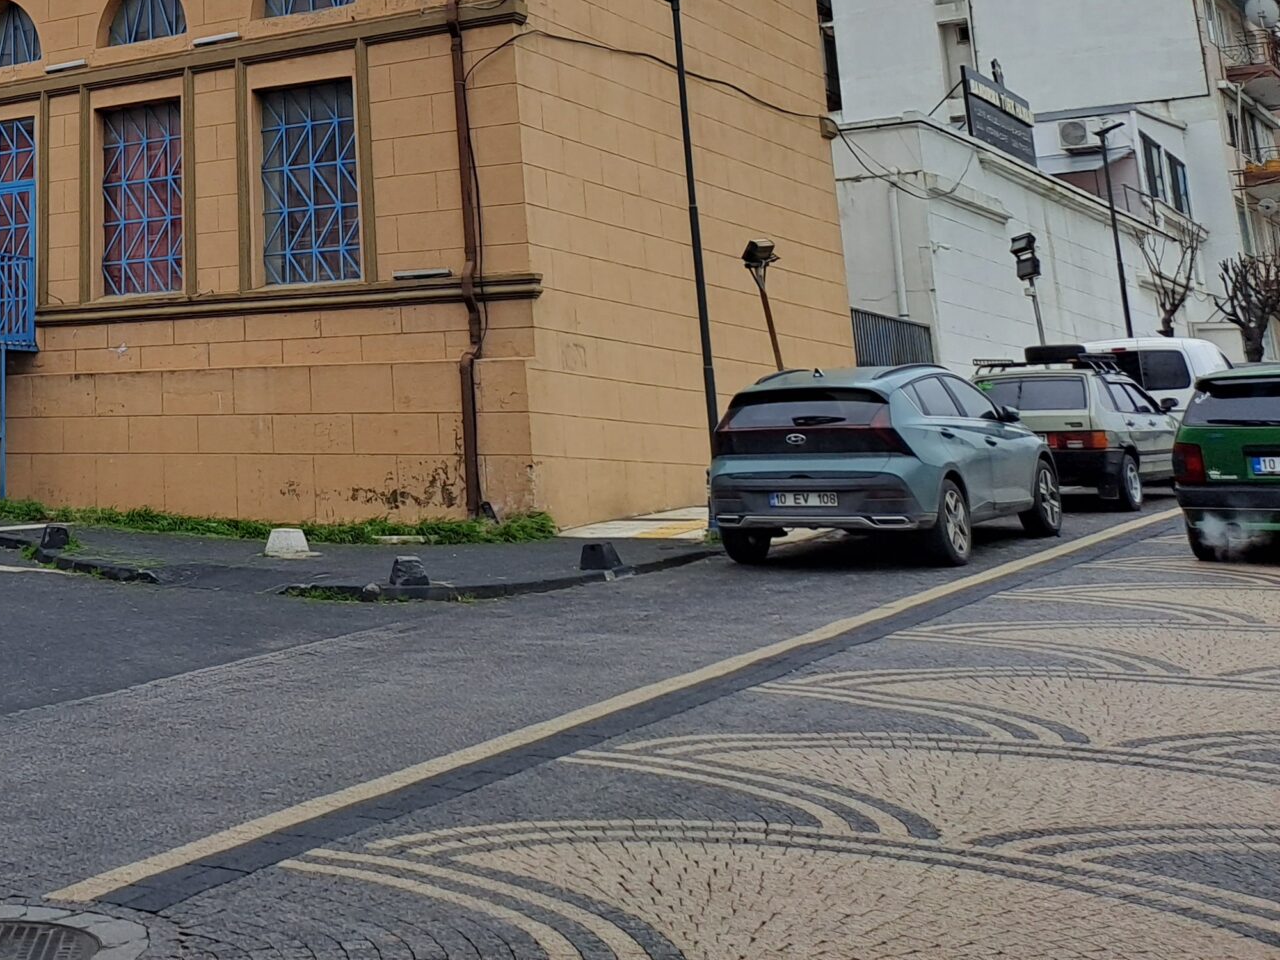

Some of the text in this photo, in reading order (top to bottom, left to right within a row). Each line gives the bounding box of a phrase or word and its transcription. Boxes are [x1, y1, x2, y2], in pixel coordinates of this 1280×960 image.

[1262, 458, 1276, 470] 10
[776, 493, 786, 505] 10
[793, 493, 810, 505] EV
